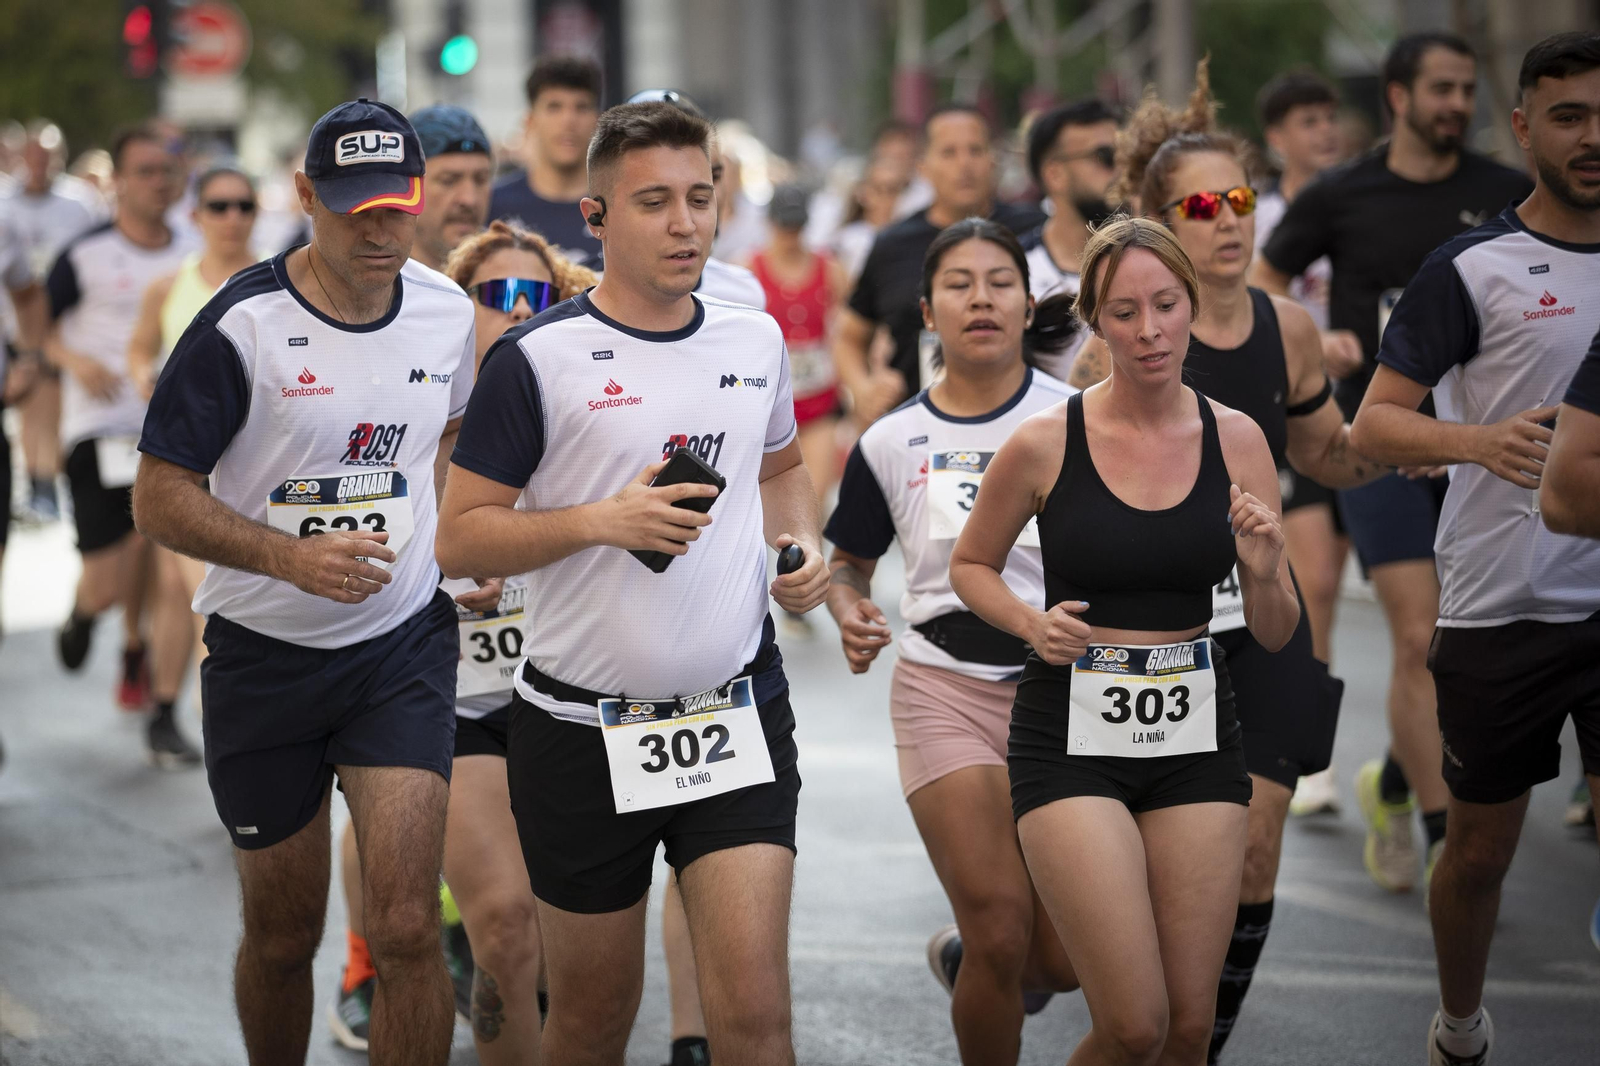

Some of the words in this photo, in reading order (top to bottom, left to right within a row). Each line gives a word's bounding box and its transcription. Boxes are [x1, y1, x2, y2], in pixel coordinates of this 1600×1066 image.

[340, 134, 400, 158] SUP
[1523, 306, 1576, 321] Santander
[743, 375, 767, 390] mupol
[281, 386, 335, 398] Santander
[588, 396, 643, 411] Santander
[285, 480, 321, 494] 200
[336, 472, 394, 498] GRANADA
[1092, 648, 1130, 663] 200
[1145, 644, 1195, 671] GRANADA
[1168, 674, 1181, 682] ALMA
[1101, 685, 1190, 726] 303
[645, 723, 656, 731] SIN
[656, 721, 673, 729] PRISA
[674, 718, 688, 727] PERO
[688, 716, 699, 725] CON
[699, 713, 715, 722] ALMA
[1132, 732, 1144, 744] LA
[1146, 730, 1165, 743] NIÑA
[638, 724, 736, 773] 302
[676, 776, 688, 789] EL
[688, 771, 712, 787] NIÑO
